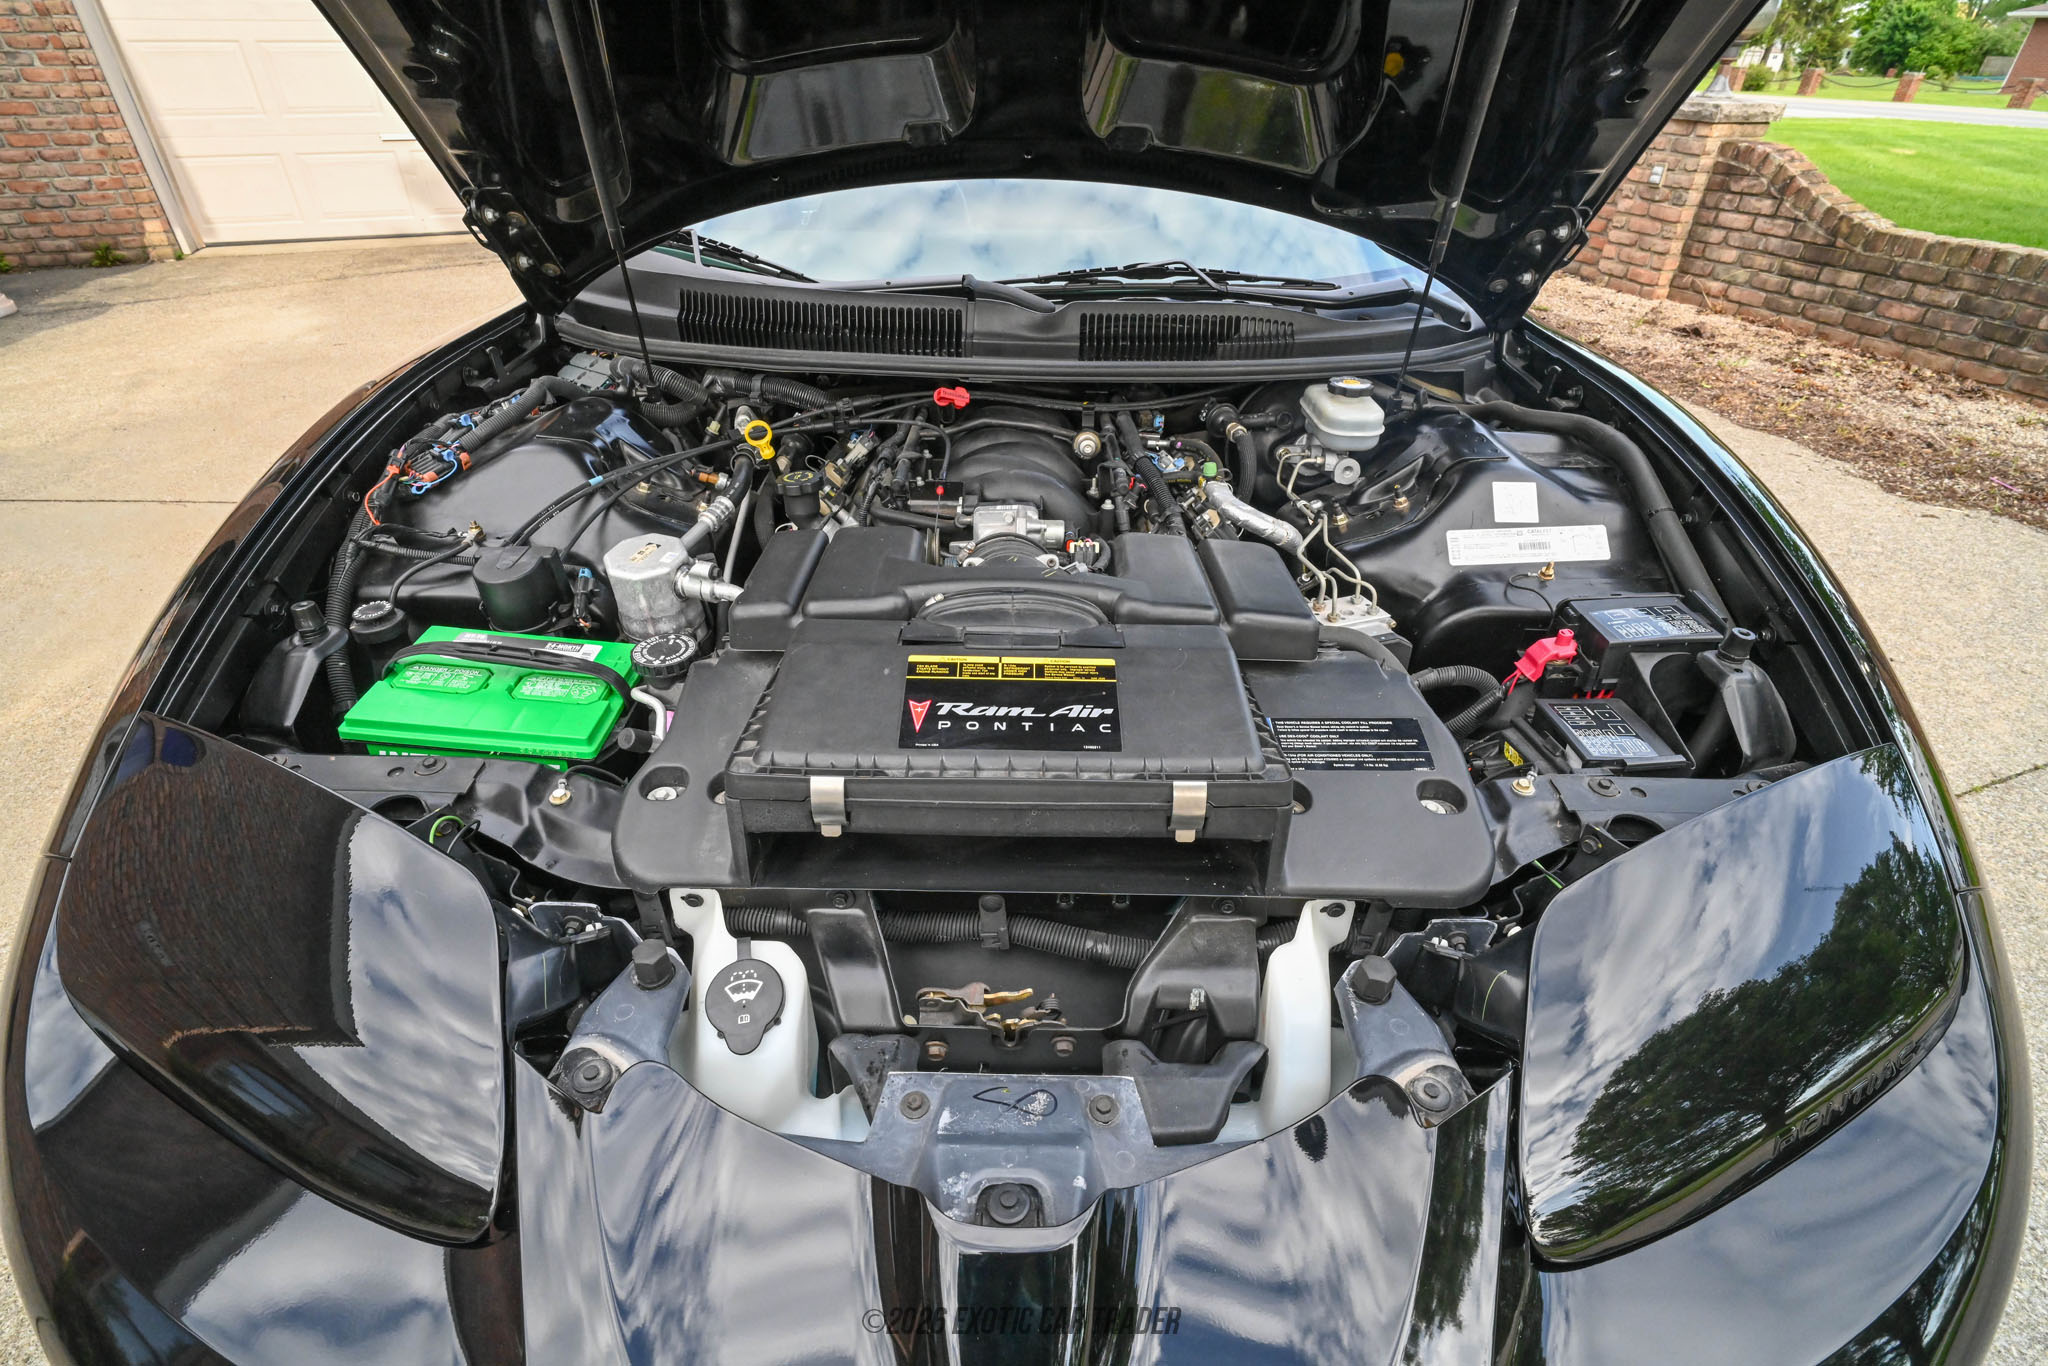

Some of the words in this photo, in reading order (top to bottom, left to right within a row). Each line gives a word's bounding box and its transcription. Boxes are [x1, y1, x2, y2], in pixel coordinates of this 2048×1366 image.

[936, 702, 1046, 718] Ram
[1048, 704, 1115, 718] Air
[937, 720, 1112, 733] PONTIAC
